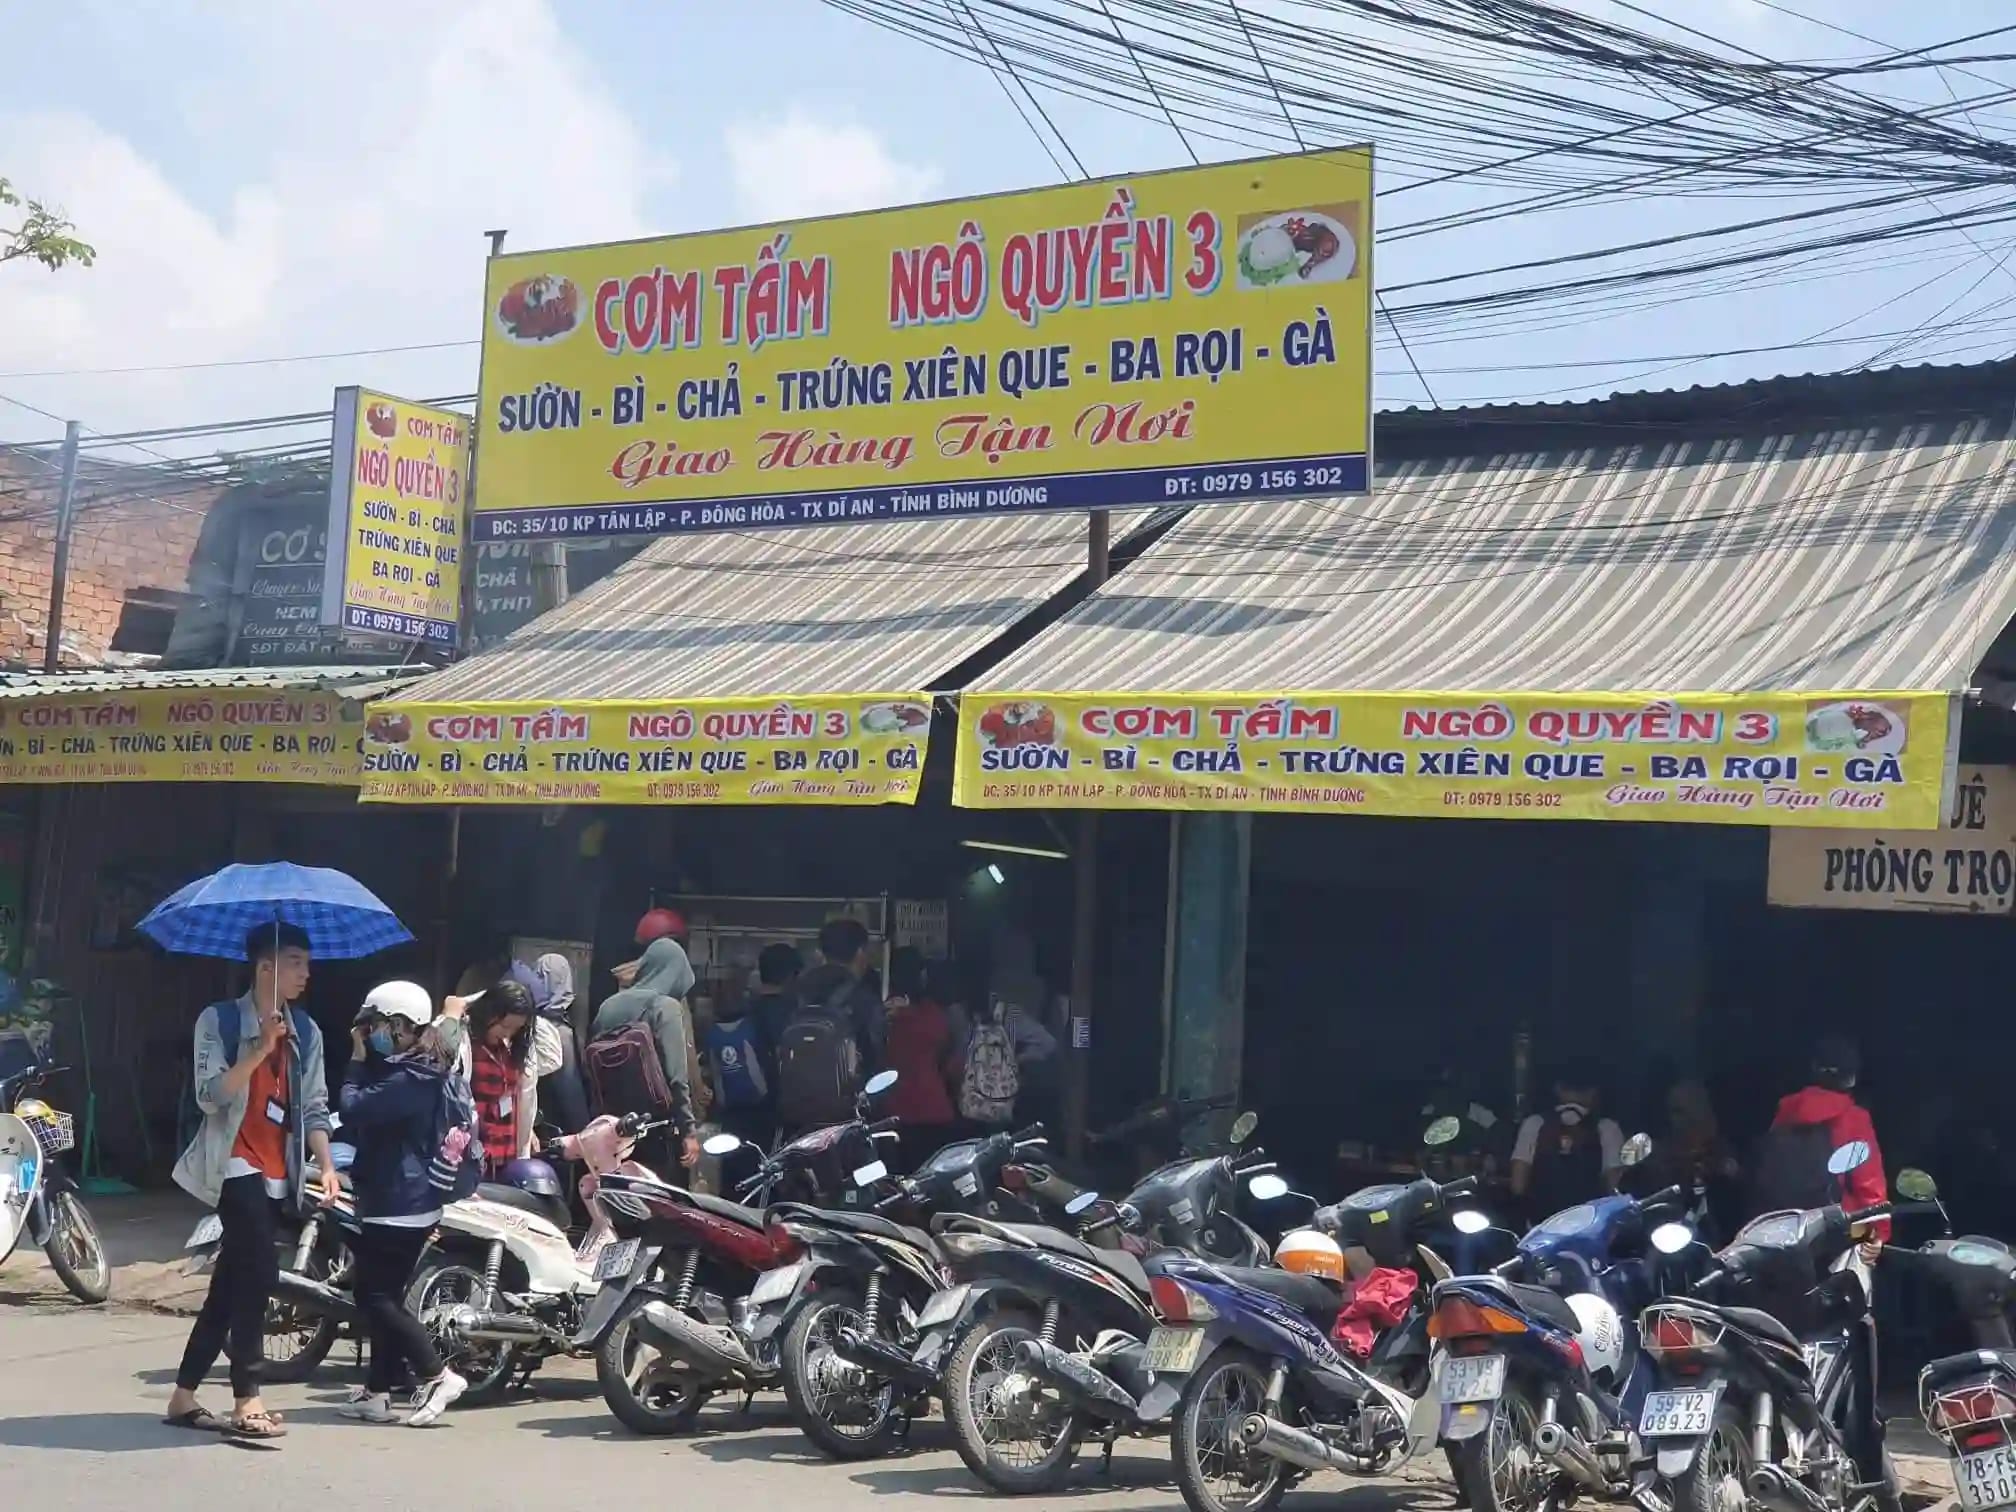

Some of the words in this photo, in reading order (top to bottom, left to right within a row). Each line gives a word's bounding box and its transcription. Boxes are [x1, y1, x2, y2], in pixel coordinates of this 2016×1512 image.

[595, 266, 701, 354] CƠM
[714, 232, 830, 350] TẤM
[889, 221, 988, 327] NGÔ
[1001, 188, 1172, 328] QUYỀN
[1185, 209, 1221, 294] 3
[498, 381, 580, 432] SƯỜN
[613, 376, 644, 425] BÌ
[677, 363, 741, 420] CHẢ
[777, 357, 891, 411] TRỨNG
[902, 347, 986, 401] XIÊN
[999, 345, 1070, 399] QUE
[1110, 337, 1161, 383] BA
[1175, 328, 1241, 384] RỌI
[1283, 307, 1335, 367] GÀ
[607, 440, 737, 489] Giao
[756, 429, 915, 470] Hàng
[936, 414, 1055, 465] Tận
[1074, 400, 1196, 447] Nơi
[358, 443, 389, 488] NGÔ
[394, 448, 444, 500] QUYỀN
[449, 469, 459, 504] 3
[1165, 476, 1197, 496] ĐT:
[1203, 473, 1252, 493] 0979
[1260, 470, 1297, 489] 156
[1303, 467, 1342, 486] 302
[363, 500, 397, 522] SƯỜN
[493, 520, 517, 536] ĐC:
[522, 515, 568, 533] 35/10
[573, 514, 595, 531] KP
[599, 510, 631, 530] TÂN
[635, 509, 666, 531] LẬP
[681, 509, 696, 526] P.
[701, 504, 746, 525] ĐÔNG
[751, 500, 785, 521] HÒA
[801, 502, 822, 518] TX
[828, 497, 845, 517] DĨ
[850, 498, 874, 515] AN
[890, 491, 930, 513] TỈNH
[937, 491, 980, 510] BÌNH
[986, 486, 1048, 506] DƯƠNG
[358, 526, 399, 552] TRỨNG
[403, 536, 431, 558] XIÊN
[435, 547, 457, 564] QUE
[372, 560, 389, 578] BA
[392, 564, 414, 585] RỌI
[373, 613, 402, 632] 0979
[428, 622, 449, 639] 302
[427, 715, 500, 740] CƠM
[510, 706, 590, 742] TẤM
[628, 709, 694, 738] NGÔ
[703, 704, 816, 741] QUYỀN
[823, 711, 848, 738] 3
[1081, 706, 1198, 738] CƠM
[1211, 698, 1339, 741] TẤM
[1403, 702, 1514, 739] NGÔ
[1528, 699, 1726, 745] QUYỀN
[1735, 711, 1777, 745] 3
[109, 733, 166, 754] TRỨNG
[172, 731, 213, 752] XIÊN
[219, 733, 253, 754] QUE
[272, 734, 300, 754] BA
[308, 735, 336, 757] RỌI
[364, 747, 420, 772] SƯỜN
[440, 748, 461, 772] BÌ
[483, 745, 529, 772] CHẢ
[552, 747, 629, 772] TRỨNG
[637, 746, 693, 771] XIÊN
[701, 750, 747, 774] QUE
[774, 749, 807, 770] BA
[816, 749, 859, 774] RỌI
[886, 744, 918, 769] GÀ
[981, 743, 1070, 772] SƯỜN
[1104, 746, 1136, 772] BÌ
[1172, 743, 1241, 773] CHẢ
[1279, 743, 1404, 775] TRỨNG
[1418, 746, 1510, 777] XIÊN
[1524, 753, 1604, 781] QUE
[1650, 756, 1709, 780] BA
[1725, 756, 1797, 786] RỌI
[1844, 752, 1903, 783] GÀ
[1004, 784, 1035, 798] 35/10
[1324, 787, 1365, 802] DƯƠNG
[1468, 791, 1502, 806] 0979
[1507, 792, 1531, 806] 156
[1536, 793, 1561, 807] 302
[1824, 837, 1934, 894] PHÒNG
[1944, 849, 2012, 906] TRỌ
[1655, 1393, 1704, 1412] 59-V2
